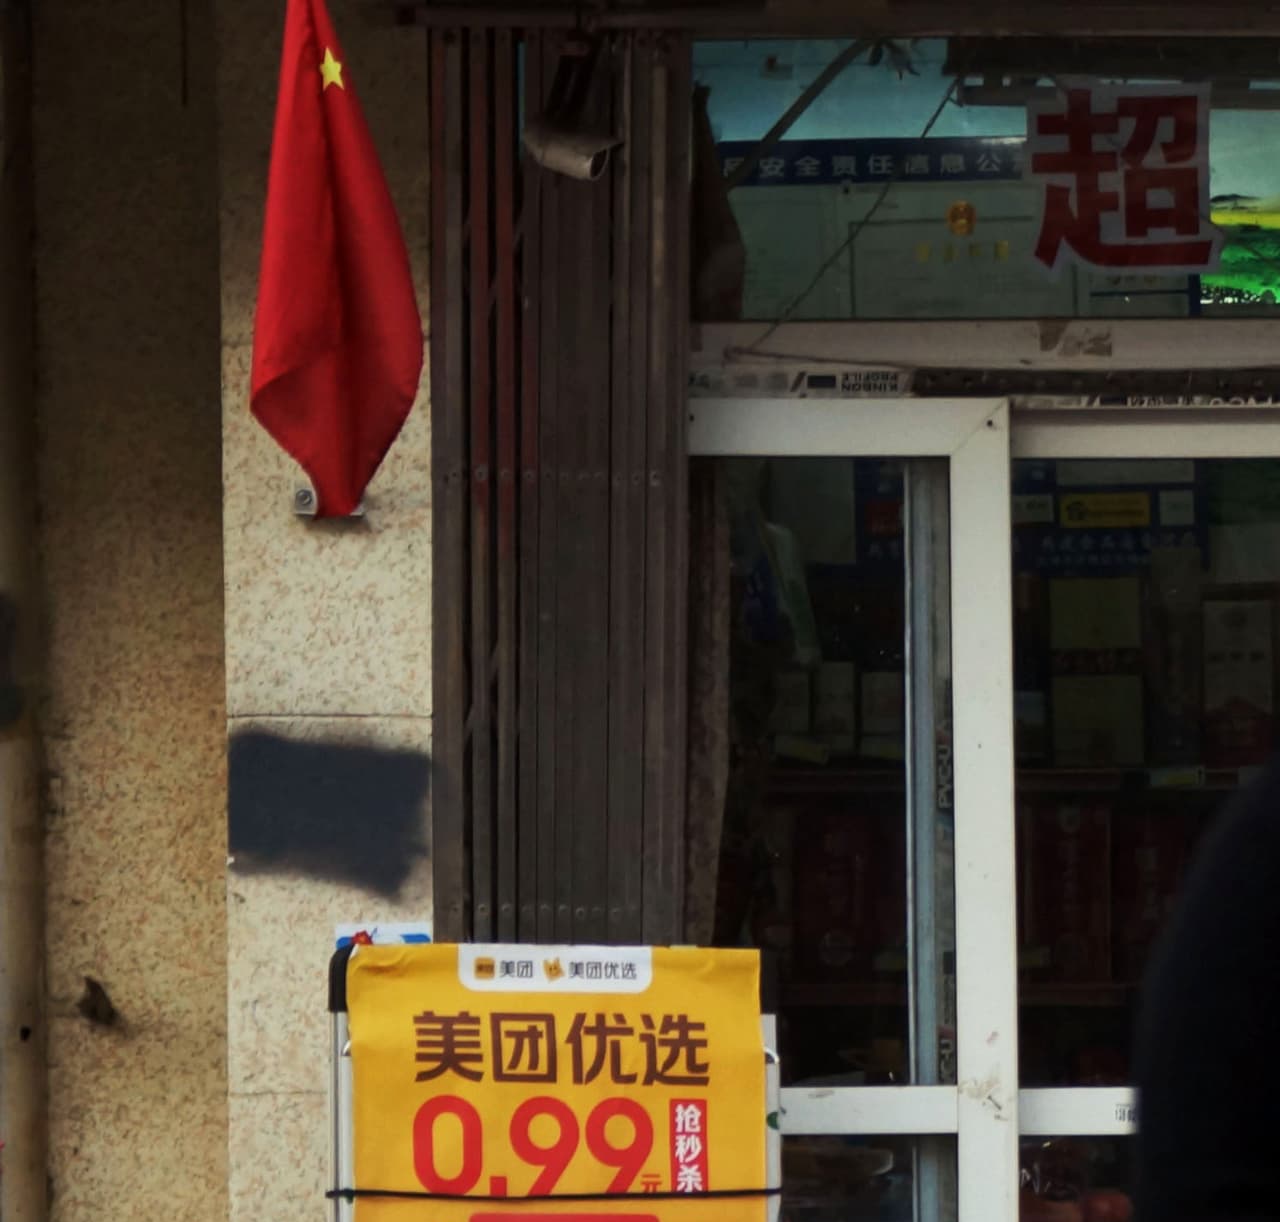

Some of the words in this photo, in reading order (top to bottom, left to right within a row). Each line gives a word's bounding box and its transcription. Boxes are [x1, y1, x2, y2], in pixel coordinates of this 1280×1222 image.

[1032, 89, 1212, 269] 超
[500, 961, 533, 978] 美团
[569, 962, 637, 980] 美团优选
[413, 1011, 711, 1086] 美团优选
[413, 1095, 655, 1197] 0.99
[675, 1104, 705, 1193] 抢秒杀
